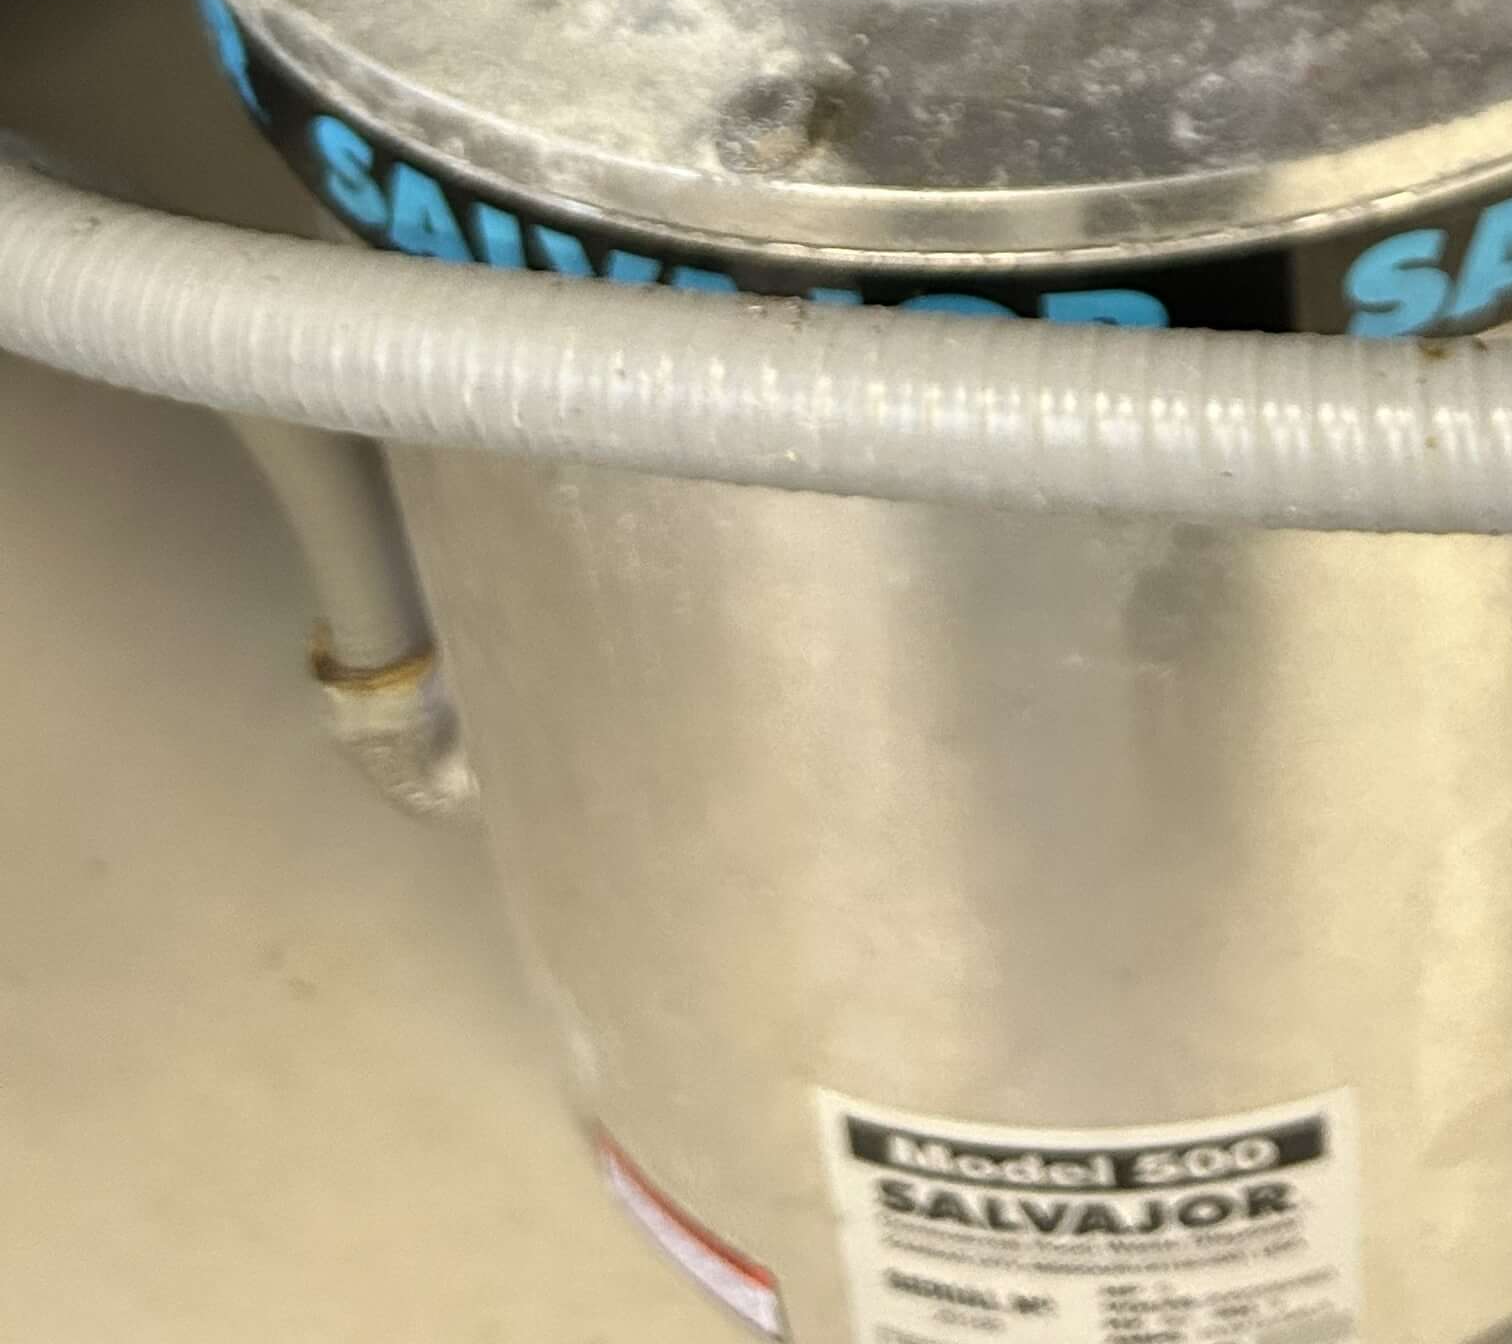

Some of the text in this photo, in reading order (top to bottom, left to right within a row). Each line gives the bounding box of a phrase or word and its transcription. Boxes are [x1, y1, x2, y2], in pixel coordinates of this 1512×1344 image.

[887, 1134, 1281, 1187] Model 500
[875, 1176, 1297, 1236] SALVAJOR
